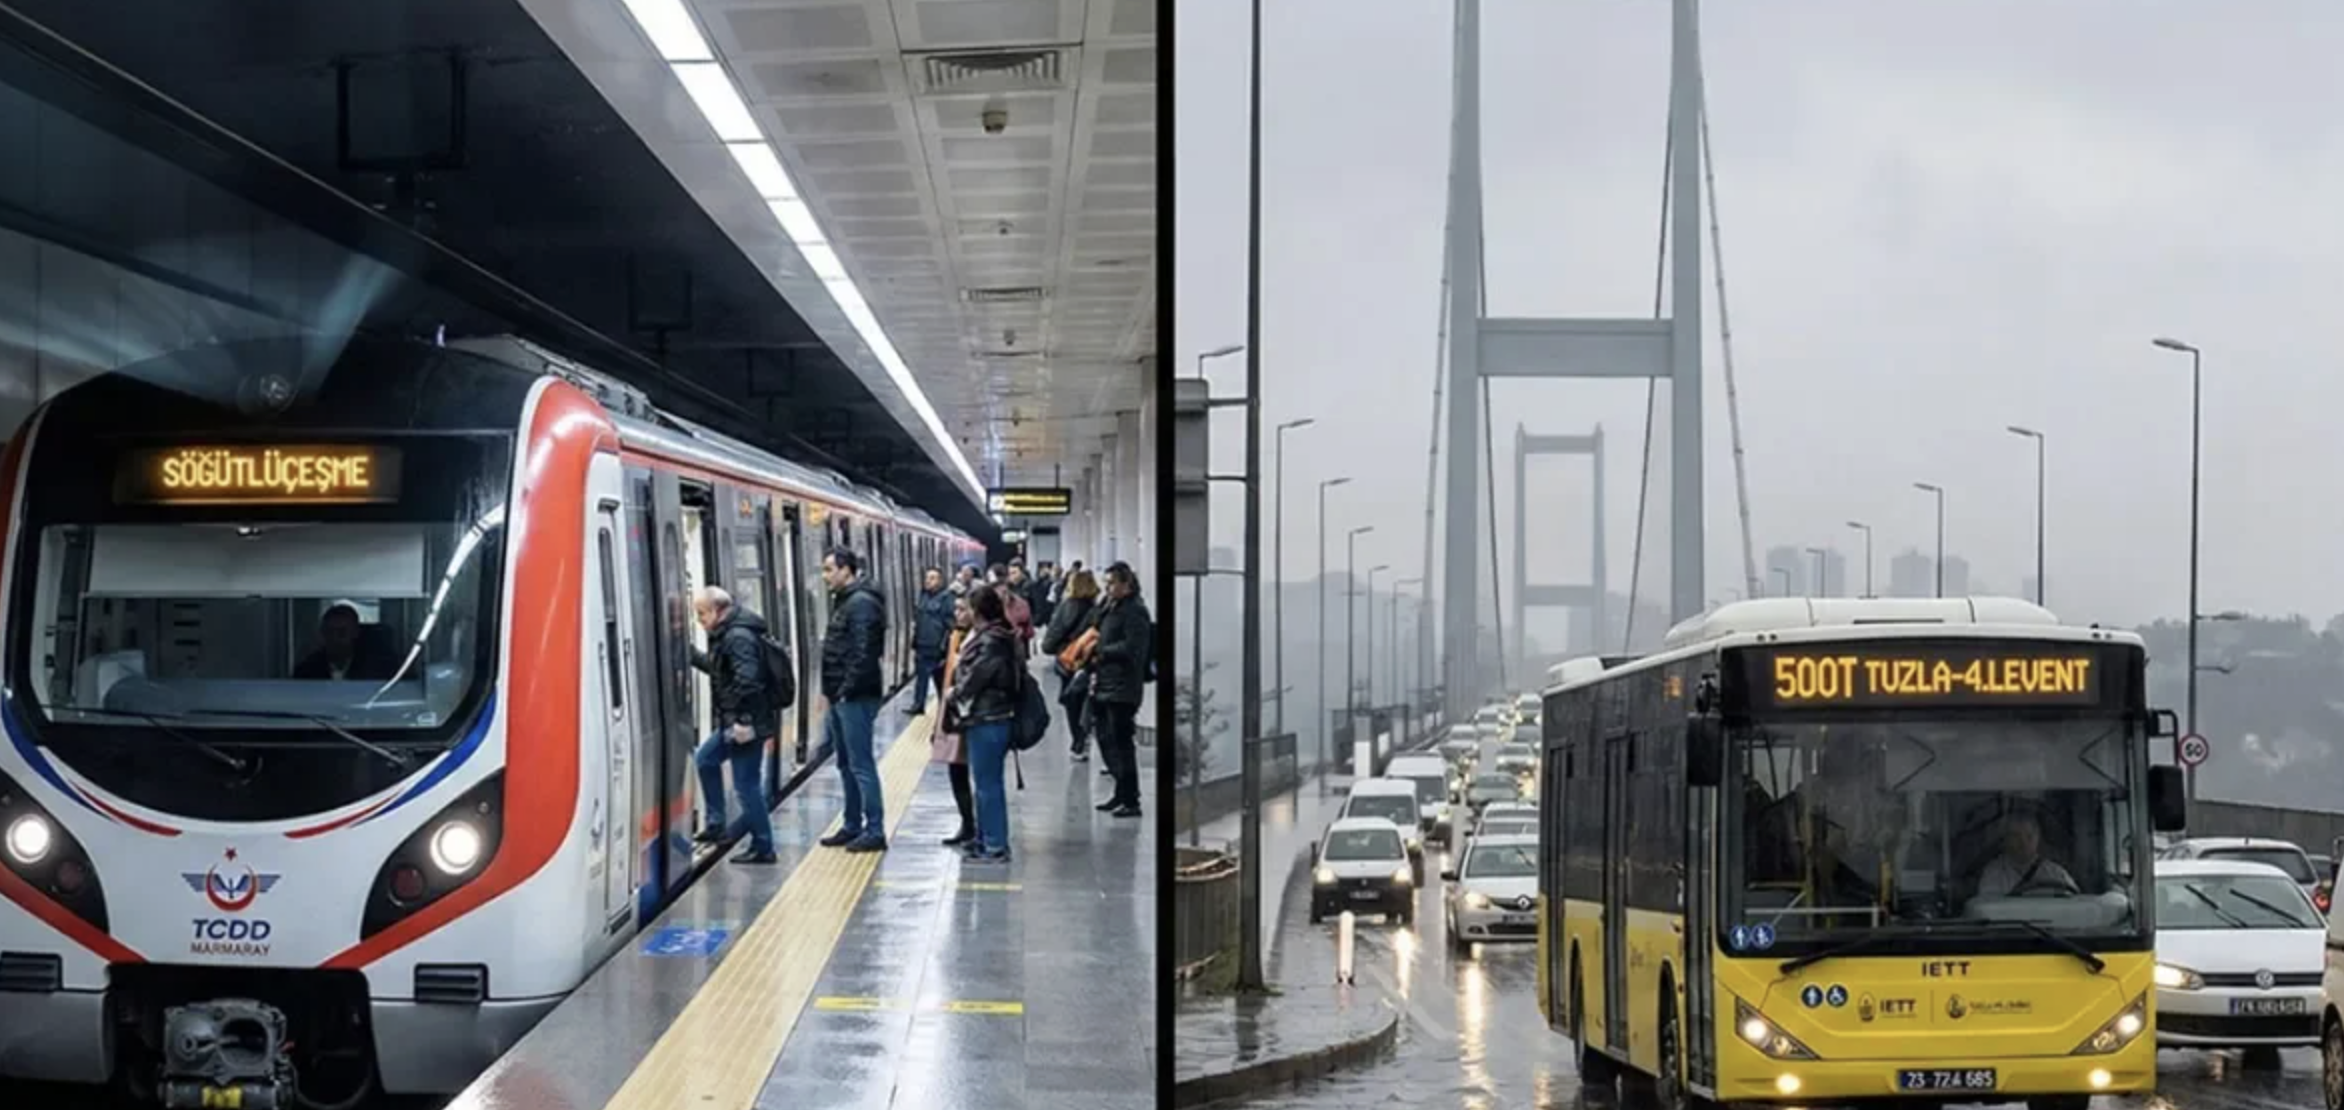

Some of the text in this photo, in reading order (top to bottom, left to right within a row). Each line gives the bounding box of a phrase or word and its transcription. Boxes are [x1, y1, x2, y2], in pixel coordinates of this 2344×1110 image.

[163, 450, 370, 494] SÖĞÜTLÜÇEŞME
[1775, 656, 1858, 699] 500T
[192, 918, 271, 940] TCDD
[191, 942, 271, 956] MARMARAY
[1922, 961, 1971, 977] IETT
[1880, 999, 1917, 1013] IETT
